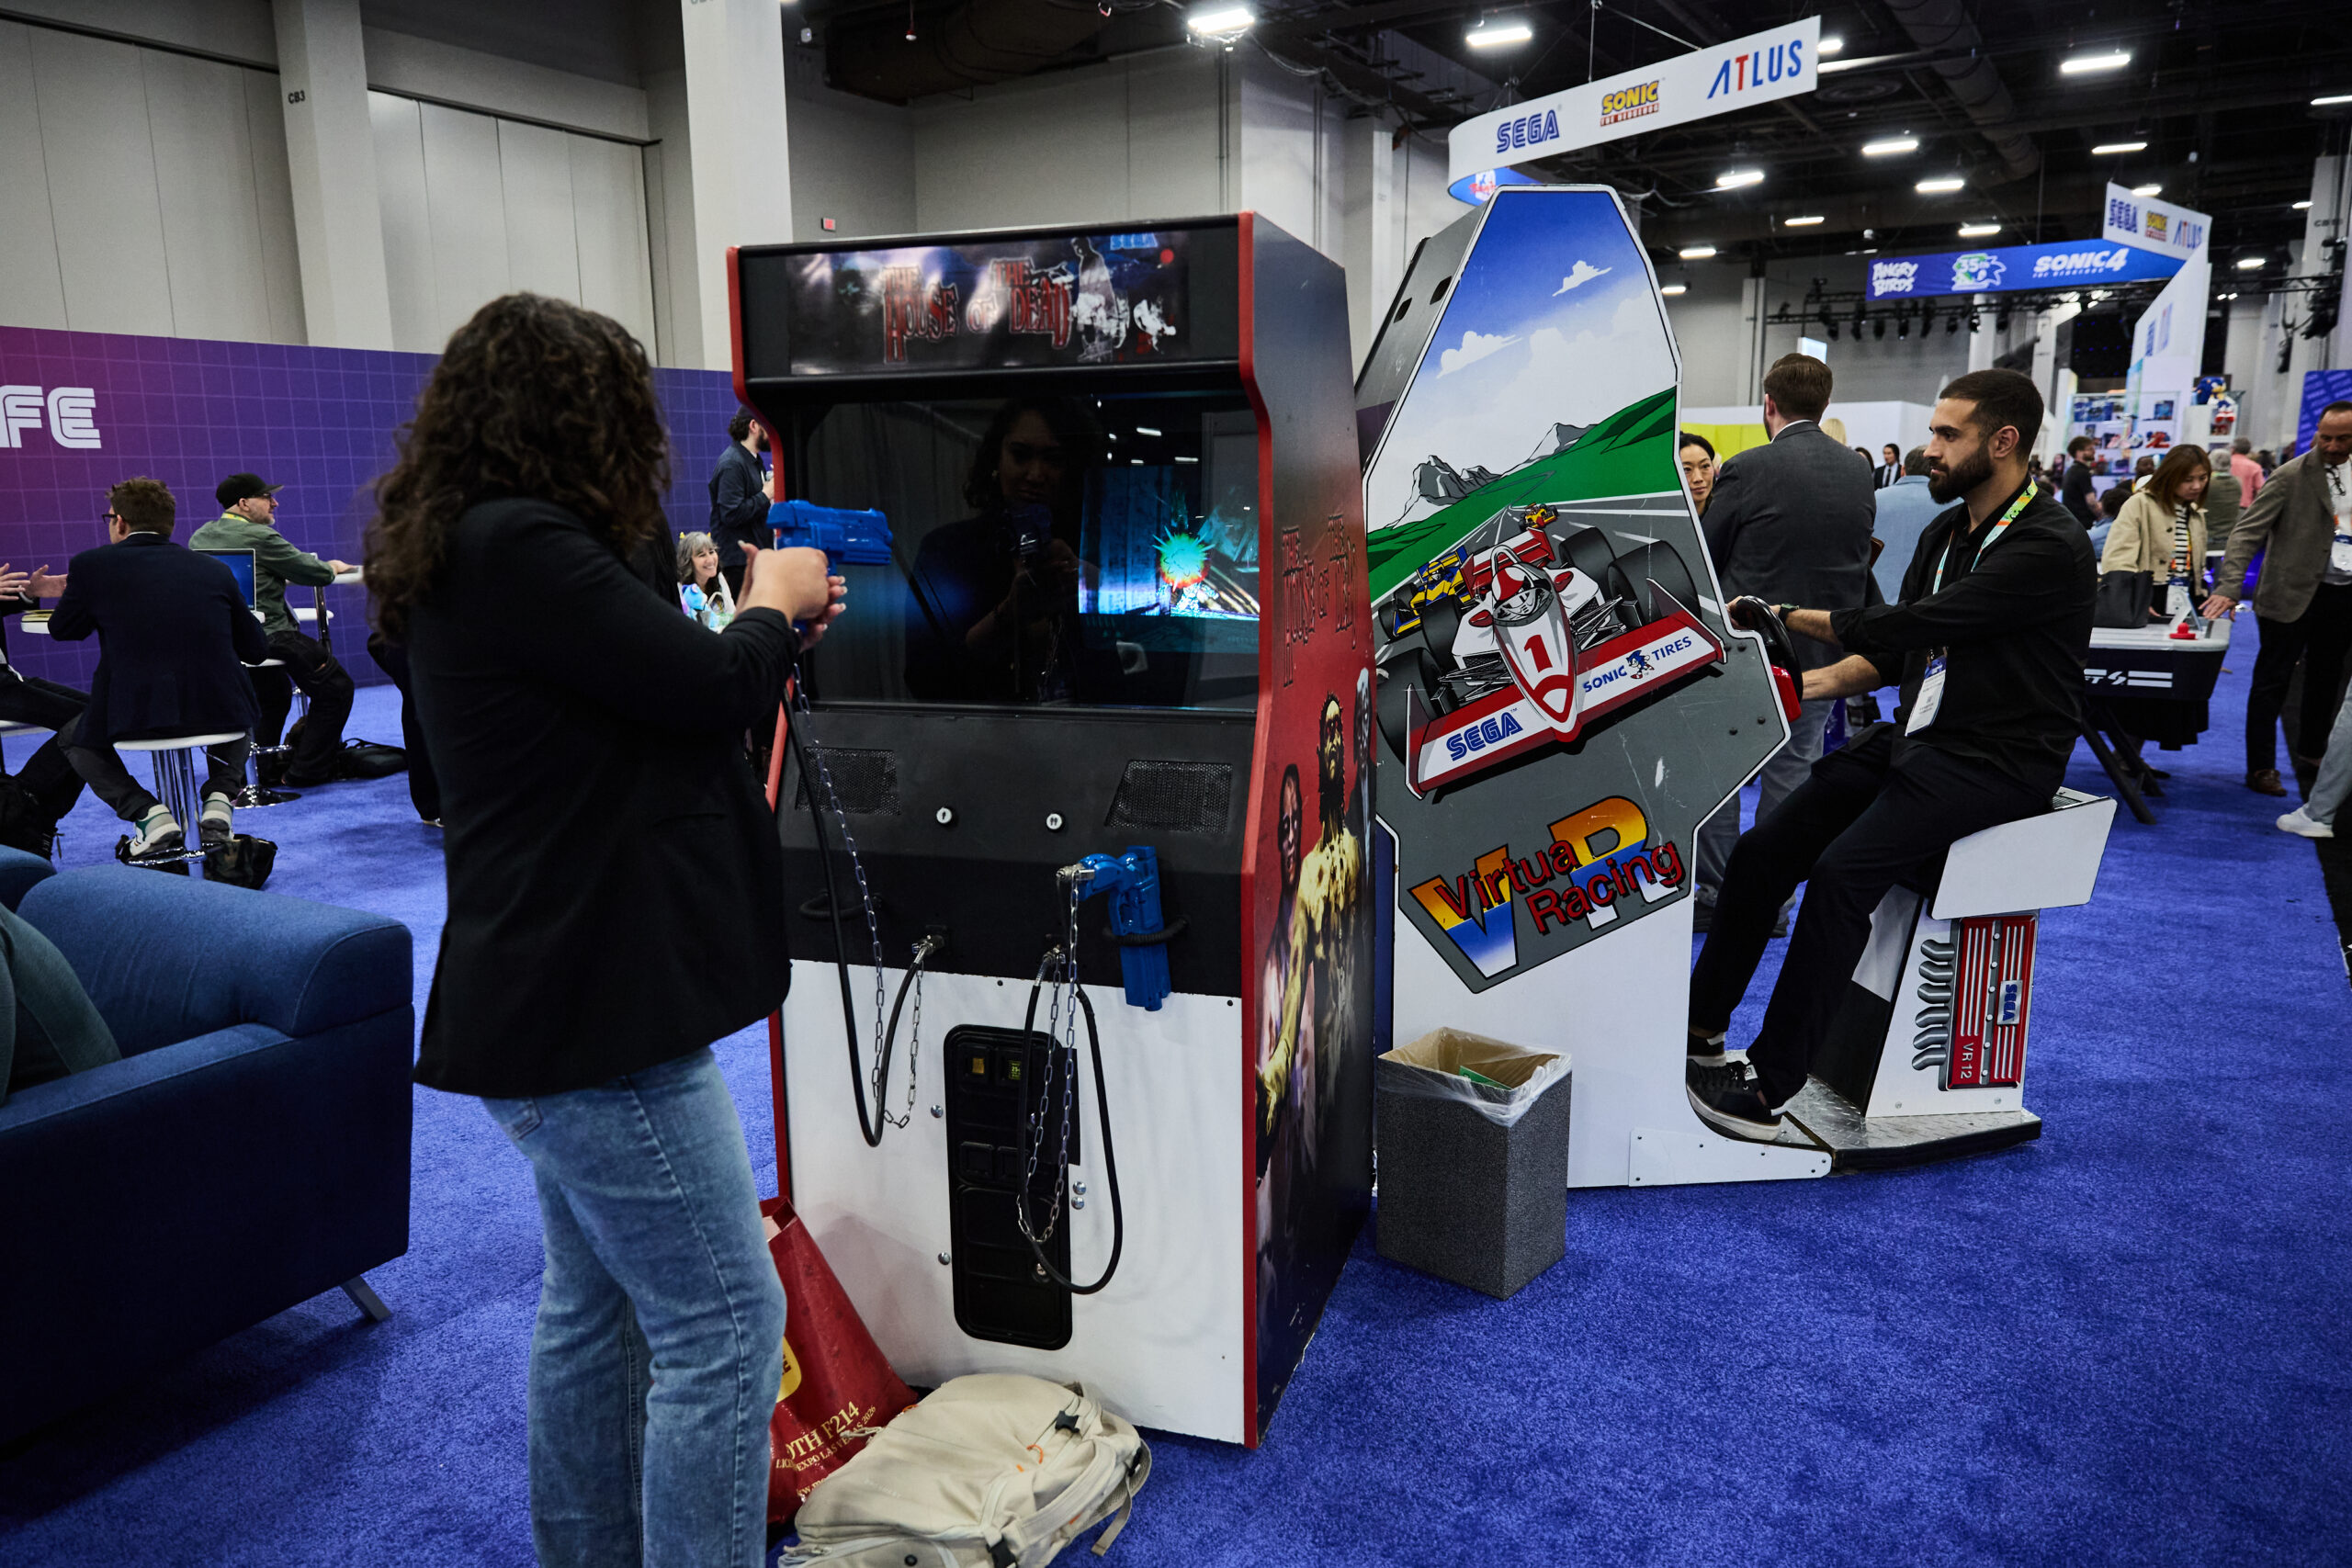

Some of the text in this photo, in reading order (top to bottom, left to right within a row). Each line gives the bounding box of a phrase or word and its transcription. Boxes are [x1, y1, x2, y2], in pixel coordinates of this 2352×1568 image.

[1707, 39, 1803, 99] ATLUS
[288, 89, 306, 104] CB3
[1601, 79, 1659, 116] SONIC
[1496, 109, 1560, 153] SEGA
[883, 267, 921, 292] THE
[990, 258, 1033, 288] THE
[1872, 262, 1918, 280] ANGRY
[2033, 251, 2110, 273] SONIC
[2105, 248, 2130, 272] 4
[1872, 277, 1915, 297] BIRDS
[884, 276, 1072, 364] HOUSE OF DEAD
[1524, 635, 1553, 673] 1
[1582, 637, 1692, 693] SONIC TIRES
[1446, 711, 1523, 761] SEGA
[1434, 840, 1581, 919] Virtua
[1525, 840, 1685, 935] Racing
[2003, 984, 2018, 1021] SEGA
[796, 1455, 820, 1472] EXPO
[820, 1443, 838, 1460] LAS
[861, 1406, 876, 1425] 2026
[820, 1401, 859, 1439] F214
